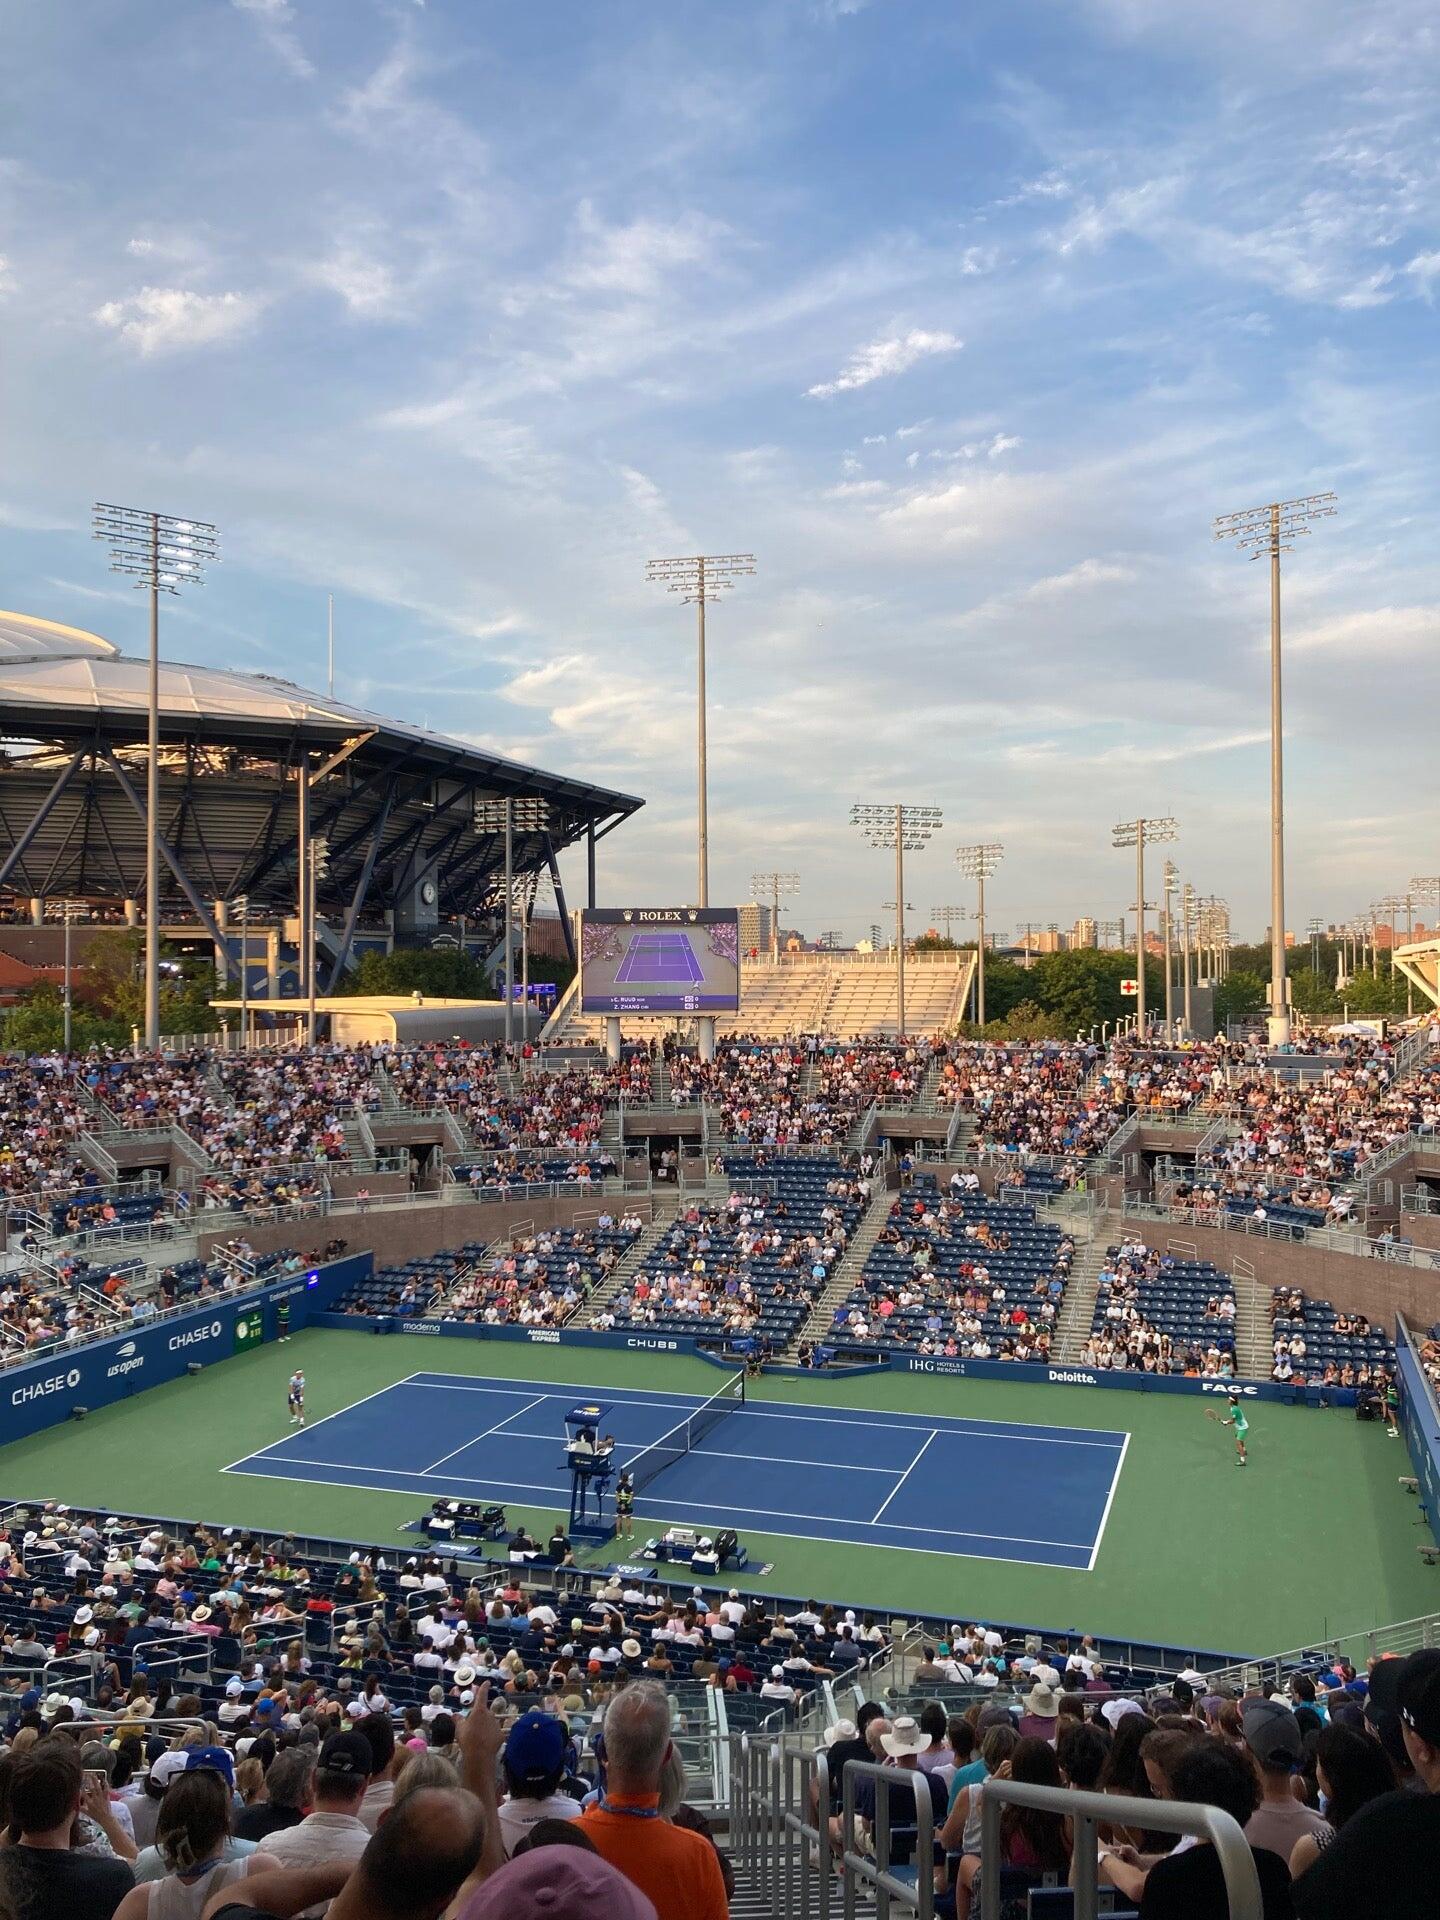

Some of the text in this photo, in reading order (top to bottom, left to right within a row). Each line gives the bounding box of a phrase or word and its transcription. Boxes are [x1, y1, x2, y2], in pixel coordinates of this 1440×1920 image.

[639, 911, 682, 921] ROLEX
[402, 1322, 441, 1332] moderna
[527, 1329, 560, 1337] AMERICAN
[168, 1325, 210, 1351] CHASE
[531, 1335, 560, 1343] EXPRESS
[627, 1338, 678, 1350] CHUBB
[107, 1356, 144, 1377] us open
[909, 1359, 935, 1372] IHG
[936, 1361, 960, 1369] HOTELS
[1048, 1370, 1097, 1384] Deloitte.
[11, 1374, 65, 1406] CHASE
